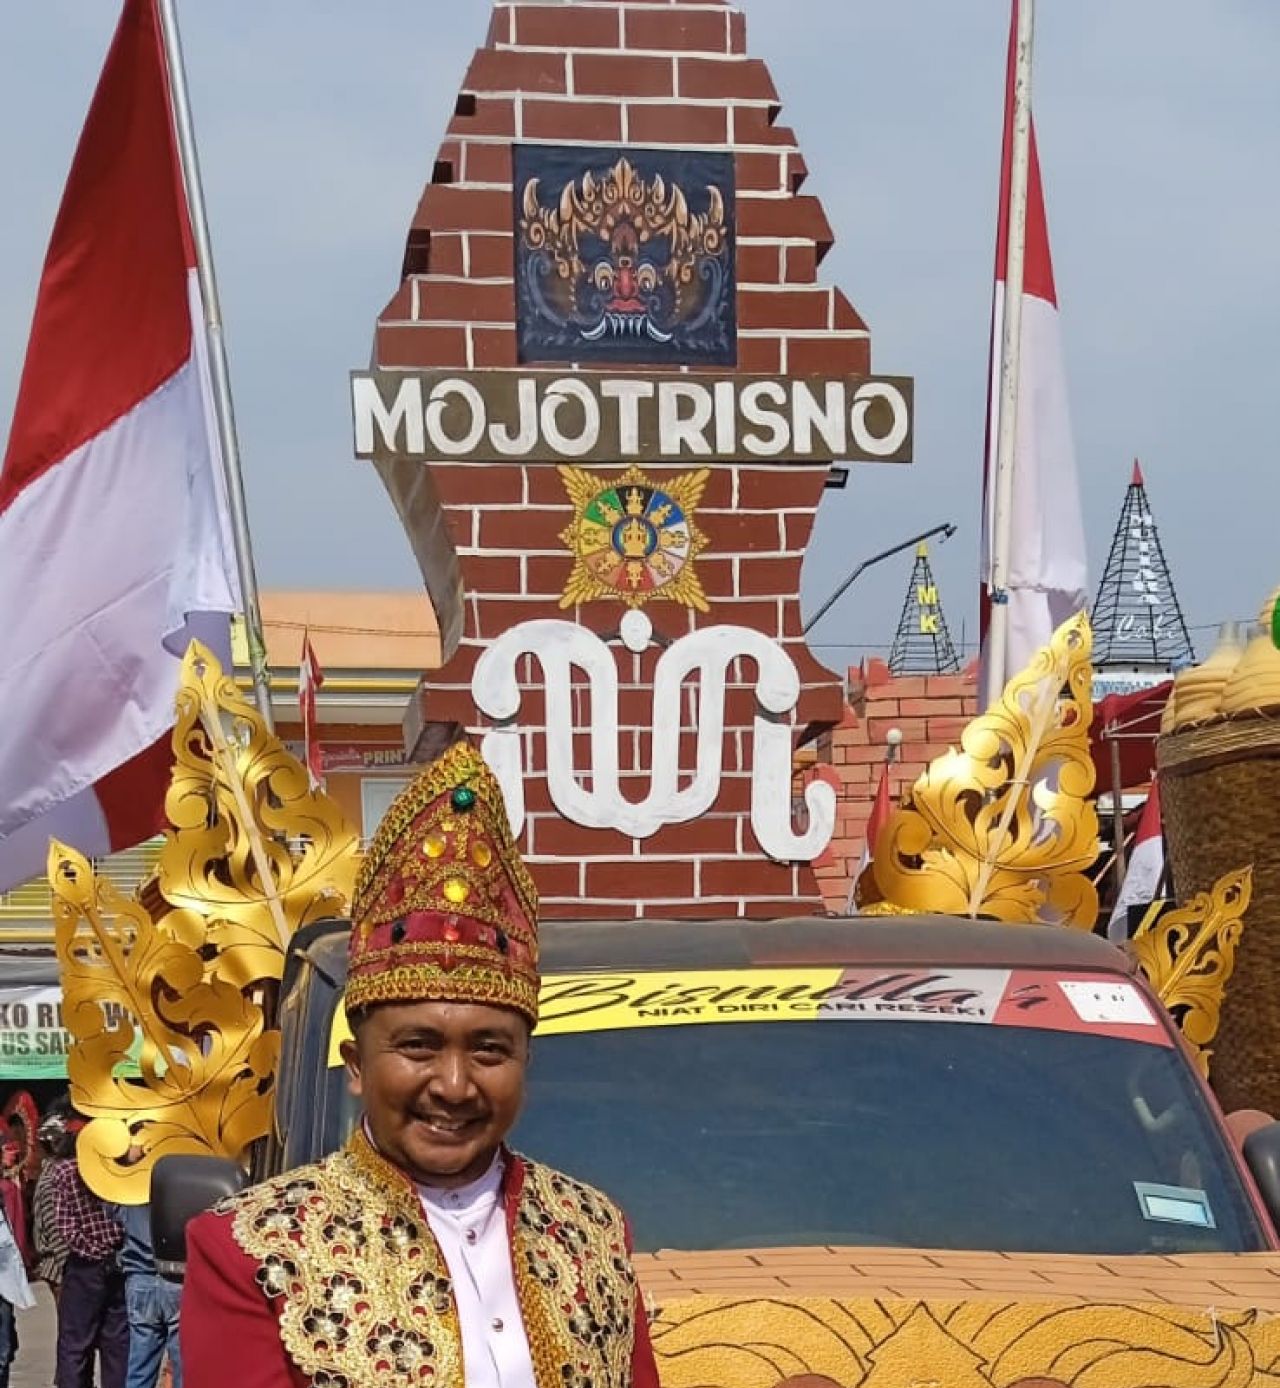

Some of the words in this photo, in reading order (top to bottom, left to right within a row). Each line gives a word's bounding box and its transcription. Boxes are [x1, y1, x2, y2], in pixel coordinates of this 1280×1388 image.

[352, 377, 908, 457] MOJOTRISNO
[363, 749, 407, 765] PRIN
[638, 1005, 702, 1017] NIAT
[718, 1003, 777, 1014] DIRI
[790, 1002, 865, 1013] CARI
[875, 1002, 986, 1016] REZEKI
